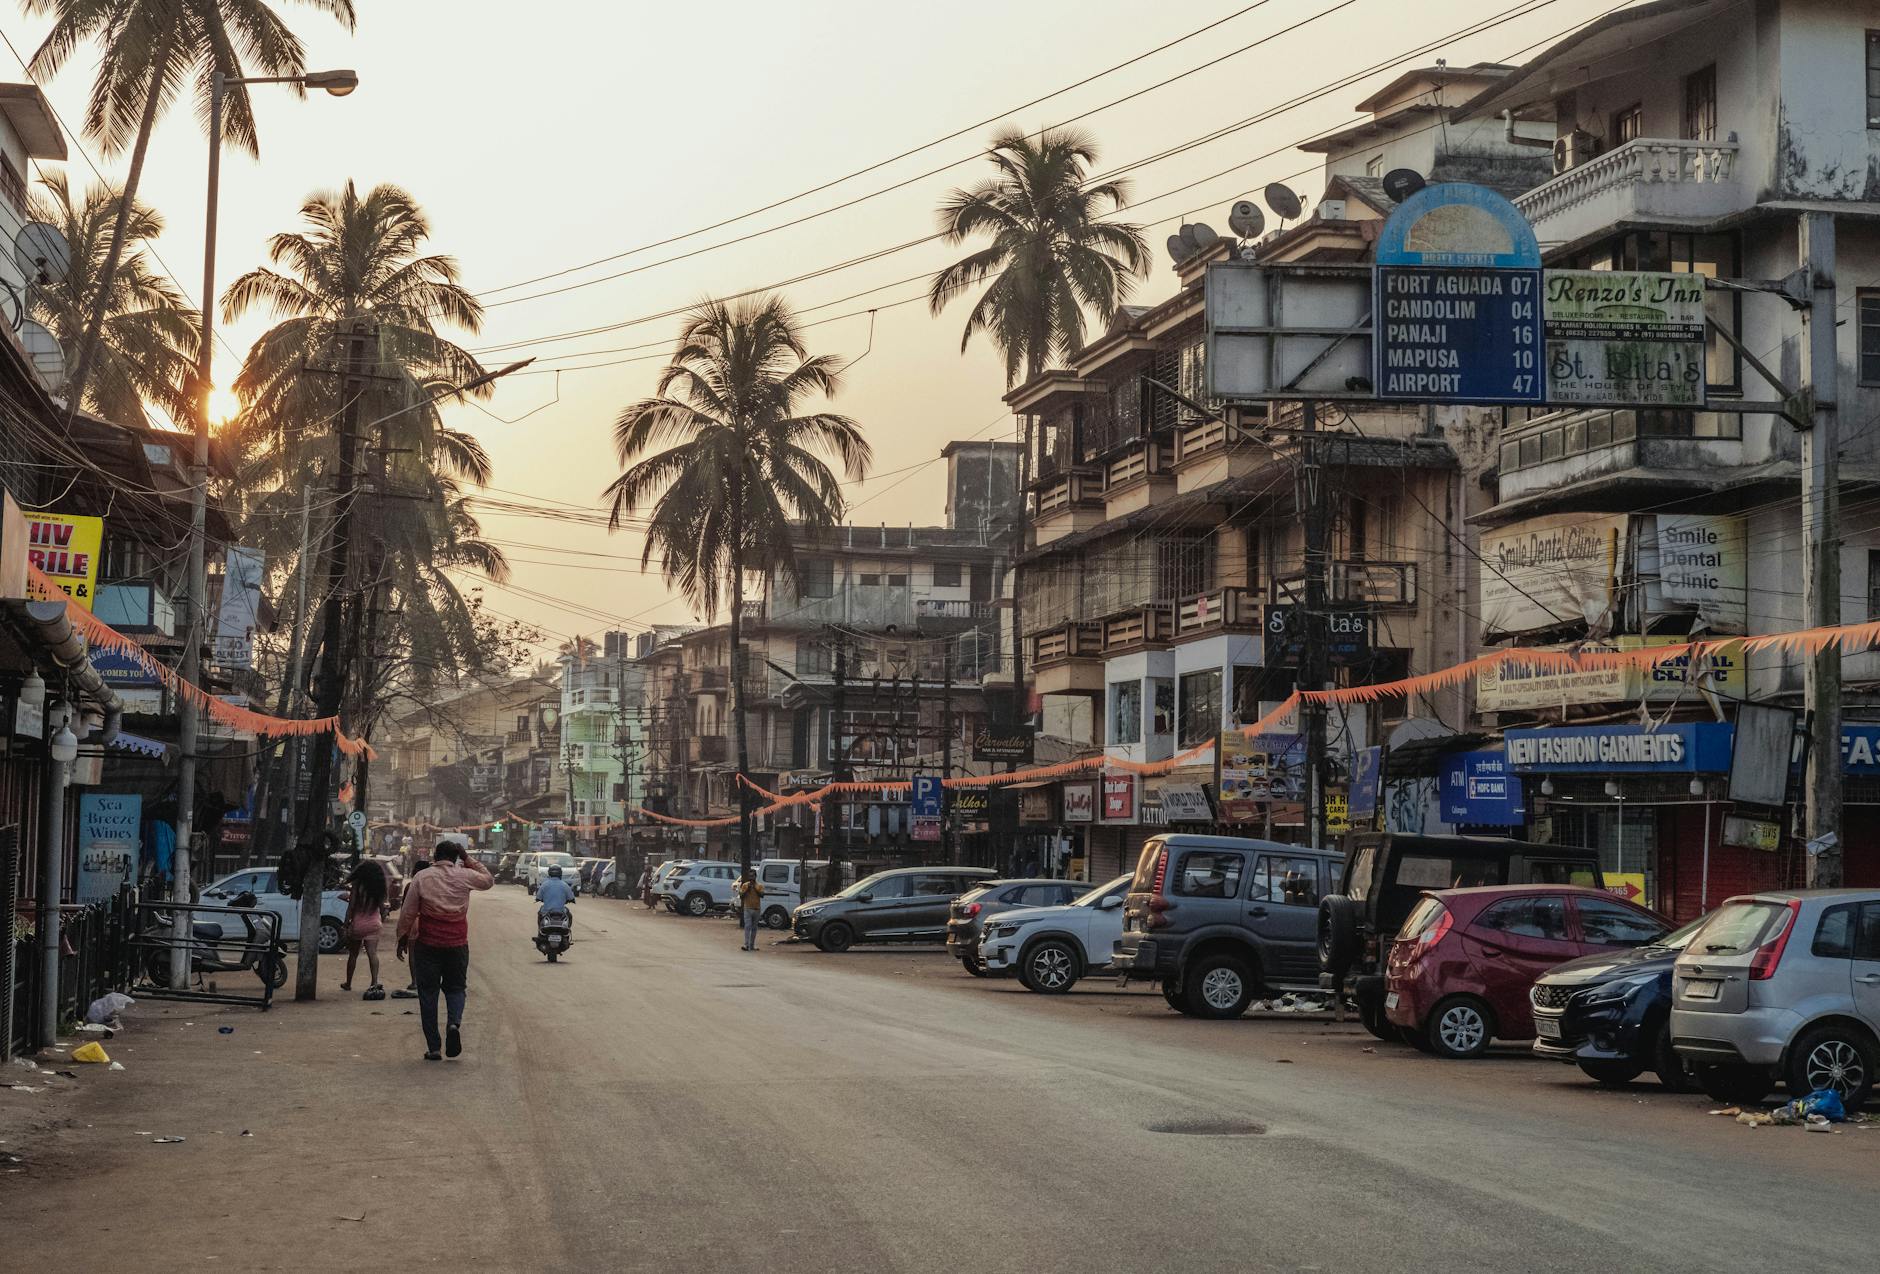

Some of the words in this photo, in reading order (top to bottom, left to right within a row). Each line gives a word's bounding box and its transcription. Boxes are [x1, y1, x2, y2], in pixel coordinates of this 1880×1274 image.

[1387, 275, 1430, 293] FORT
[1435, 276, 1502, 295] AGUADA
[1511, 277, 1532, 295] 07
[1547, 276, 1642, 303] Renzo's
[1650, 278, 1702, 303] Inn
[1387, 299, 1475, 319] CANDOLIM
[1511, 301, 1532, 319] 04
[1620, 313, 1664, 321] RESTAURANT
[1387, 324, 1446, 343] PANAJI
[1512, 326, 1532, 344] 16
[1387, 349, 1459, 368] MAPUSA
[1512, 351, 1533, 369] 10
[1550, 350, 1594, 380] St.
[1605, 352, 1701, 383] Rita's
[1387, 373, 1461, 393] AIRPORT
[1512, 375, 1533, 393] 47
[1585, 382, 1631, 390] HOUSE
[1660, 384, 1697, 392] STYLE
[1644, 394, 1664, 402] KIDS
[1666, 527, 1717, 544] Smile
[1498, 538, 1527, 575] Smile
[1530, 533, 1565, 568] Dental
[1567, 528, 1602, 562] Clinic
[1664, 551, 1721, 567] Dental
[76, 583, 88, 597] &
[1667, 573, 1718, 590] Clinic
[1329, 612, 1364, 633] ta's
[1652, 670, 1727, 682] CLIC
[1508, 744, 1538, 765] NEW
[1538, 741, 1598, 763] FASHION
[1598, 734, 1683, 763] GARMENTS
[1451, 771, 1465, 787] ATM
[918, 779, 933, 800] P
[1477, 783, 1490, 793] HDFC
[1491, 783, 1504, 793] BANK
[97, 798, 122, 811] Sea
[1330, 806, 1345, 814] CARS
[85, 812, 135, 825] Breeze
[1142, 807, 1168, 825] TATTOO
[87, 826, 132, 839] Wines
[1762, 823, 1777, 840] ELVIS
[1606, 886, 1628, 896] 2365
